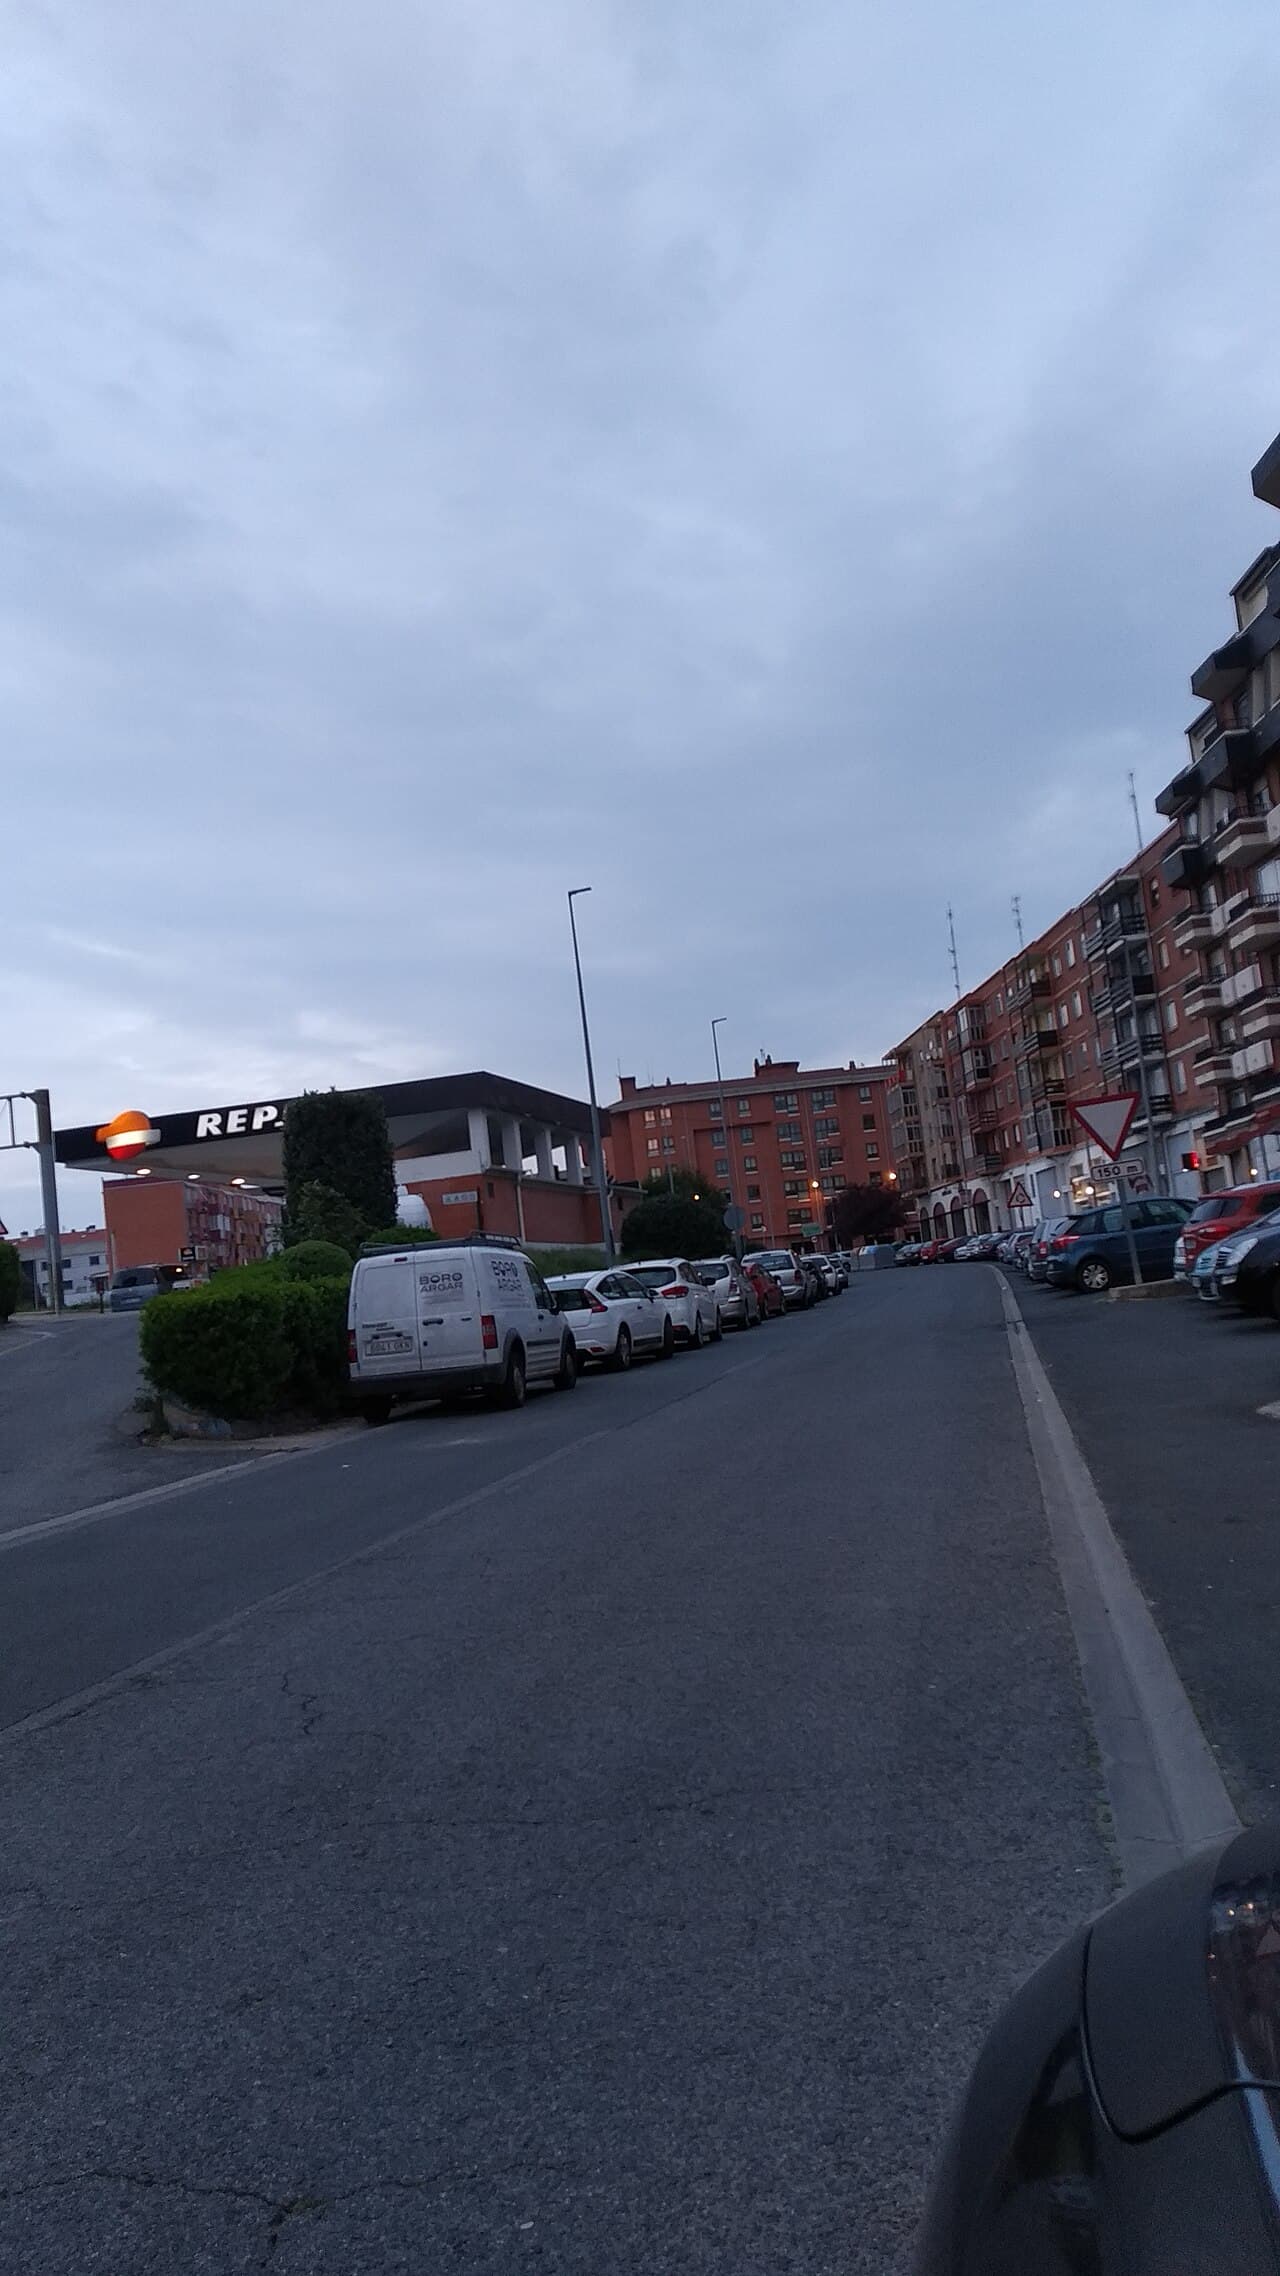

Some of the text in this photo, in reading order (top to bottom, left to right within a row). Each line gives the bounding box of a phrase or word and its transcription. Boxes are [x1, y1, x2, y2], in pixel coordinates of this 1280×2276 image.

[196, 1105, 284, 1138] REP
[1097, 1165, 1138, 1177] 150 m
[419, 1272, 463, 1286] BORO
[420, 1281, 464, 1293] ARGAR
